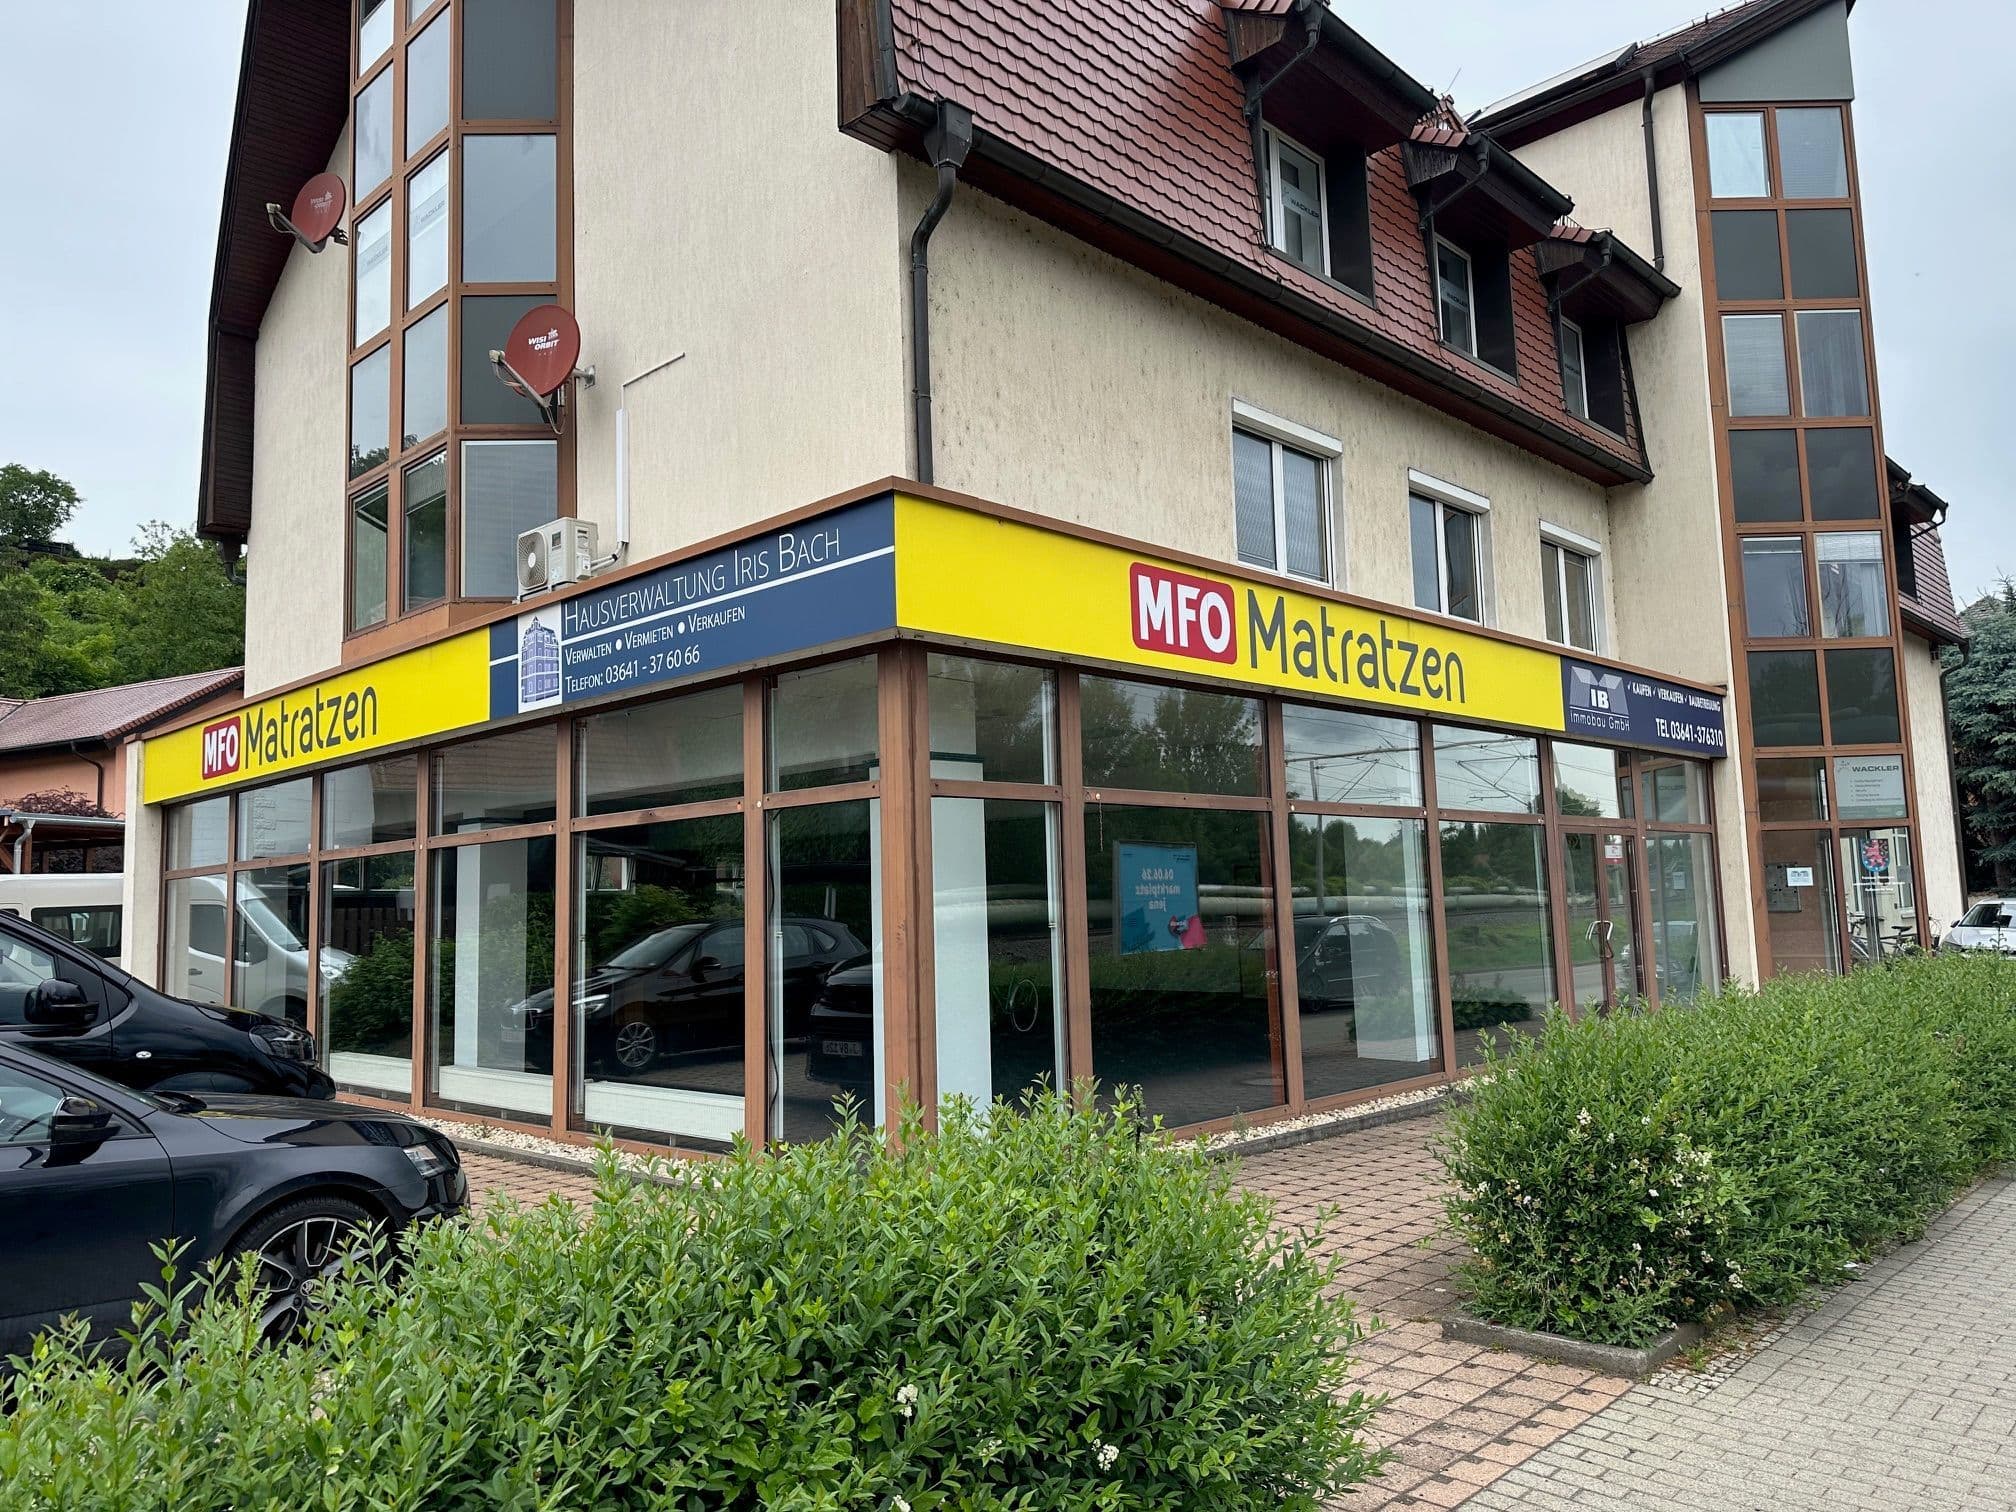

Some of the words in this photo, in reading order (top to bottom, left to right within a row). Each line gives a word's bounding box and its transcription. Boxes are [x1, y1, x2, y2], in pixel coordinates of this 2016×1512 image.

[528, 335, 547, 345] WISI
[534, 339, 560, 350] ORBIT
[564, 564, 725, 636] HAUSVERWALTUNG
[733, 549, 770, 586] IRIS
[777, 528, 841, 572] BACH
[564, 641, 613, 666] VERWALTEN
[624, 624, 674, 651] VERMIETEN
[688, 605, 746, 633] VERKAUFEN
[1137, 574, 1231, 654] MFO
[1247, 588, 1466, 704] Matratzen
[564, 671, 604, 694] TELEFON:
[605, 661, 639, 684] 03641
[649, 652, 665, 673] 37
[666, 648, 683, 670] 60
[684, 644, 701, 666] 66
[1591, 688, 1610, 710] IB
[1632, 682, 1653, 698] KAUFEN
[1657, 688, 1684, 704] VERKAUFEN
[202, 725, 239, 776] MFO
[245, 686, 378, 769] Matratzen
[1608, 715, 1630, 731] GmbH
[1655, 717, 1671, 738] TEL
[1671, 720, 1724, 747] 03641-376310
